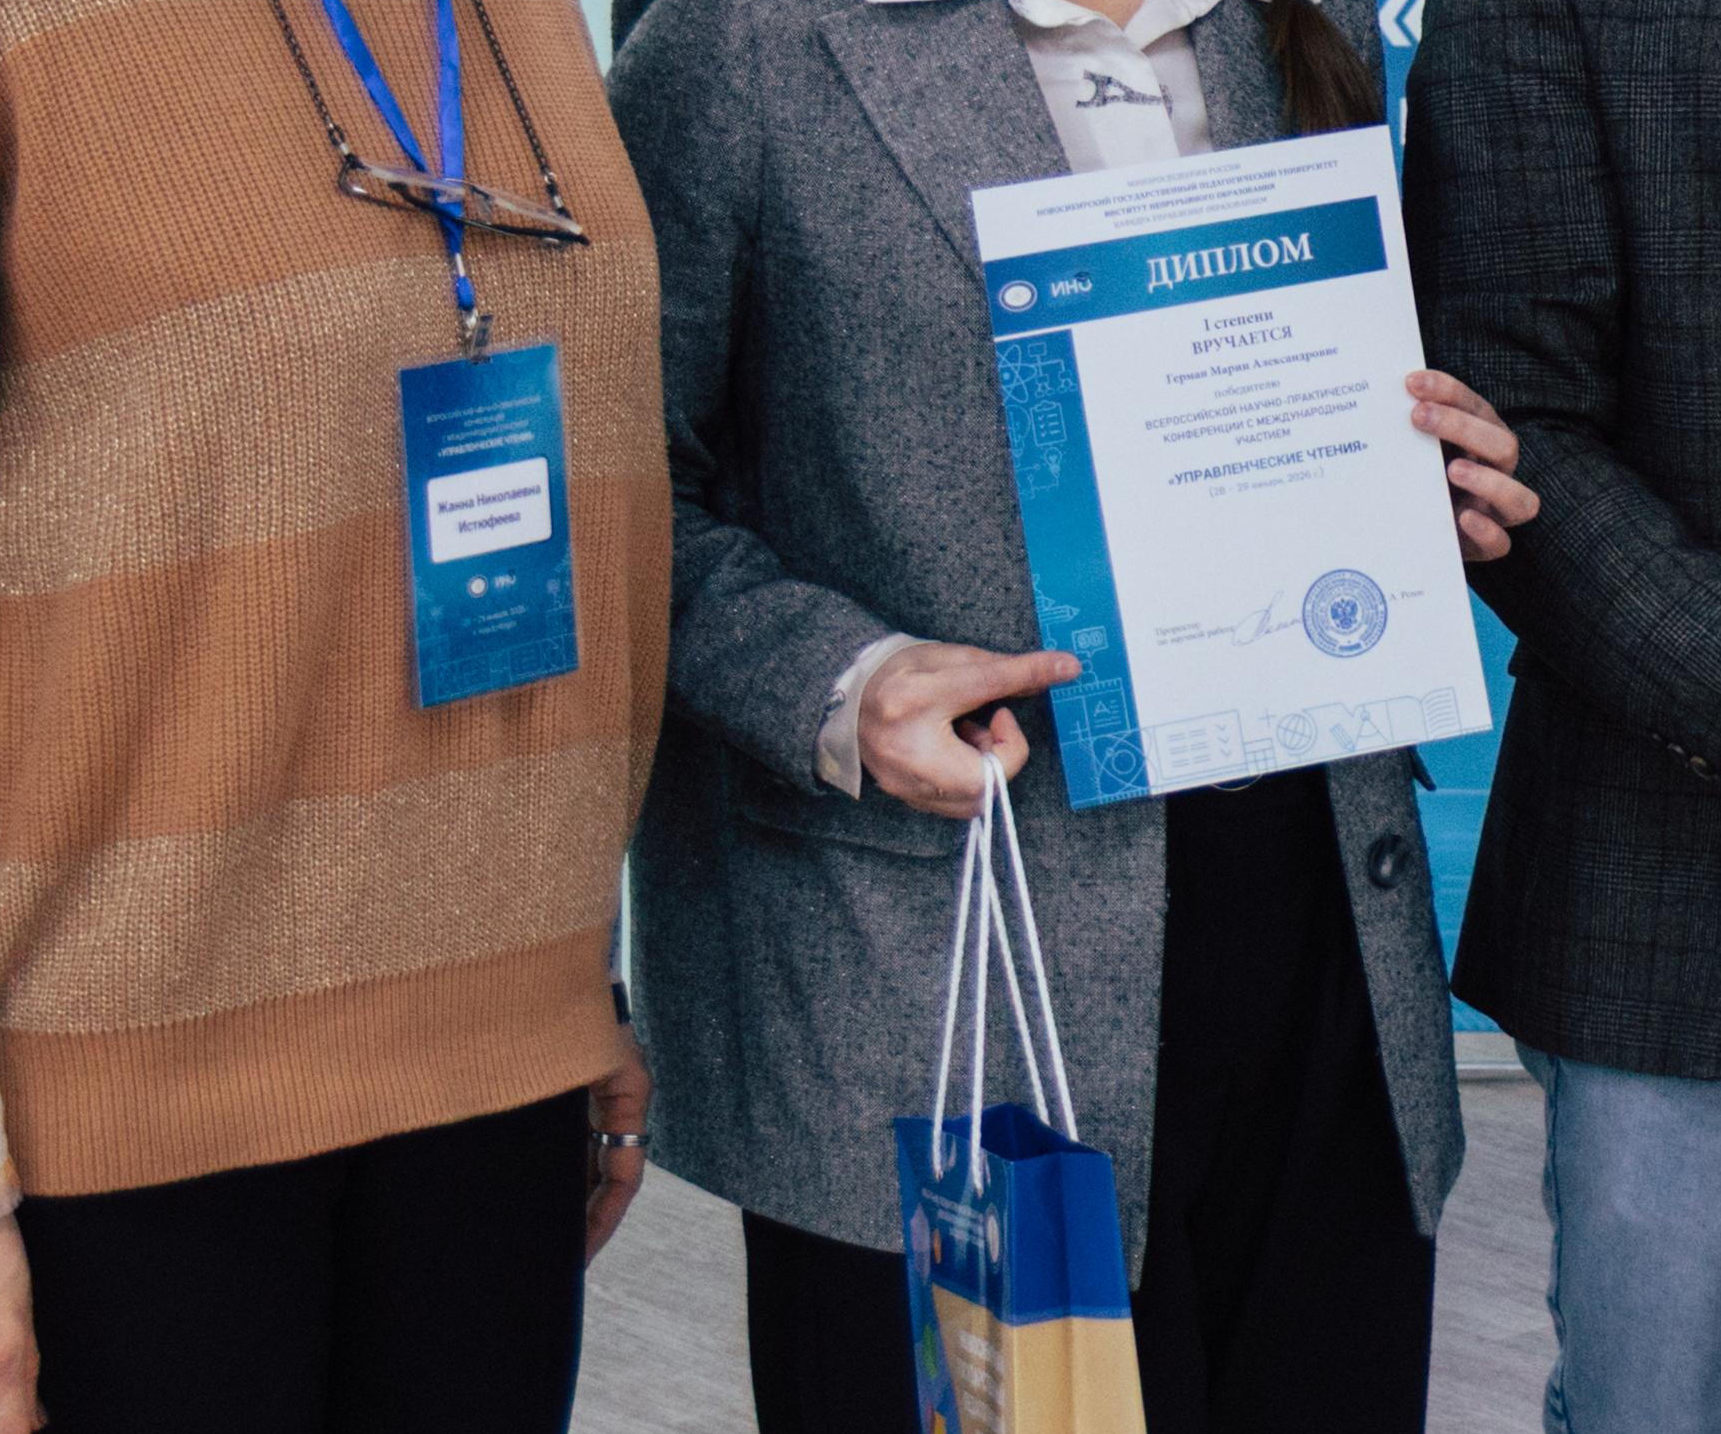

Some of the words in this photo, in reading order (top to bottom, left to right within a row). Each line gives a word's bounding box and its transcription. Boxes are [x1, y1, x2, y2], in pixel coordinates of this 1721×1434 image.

[1148, 233, 1313, 292] ДИПЛОМ
[1192, 326, 1292, 354] ВРУЧАЕТСЯ
[1203, 318, 1211, 332] I
[1214, 312, 1273, 329] степени
[1145, 404, 1237, 430] ВСЕРОССИЙСКОЙ
[1239, 381, 1369, 412] НАУЧНО-ПРАКТИЧЕСКОЙ
[1163, 421, 1244, 442] КОНФЕРЕНЦИИ
[1246, 418, 1254, 429] С
[1256, 401, 1357, 426] МЕЖДУНАРОДНЫМ
[1236, 428, 1290, 445] УЧАСТИЕМ
[1169, 451, 1303, 484] «УПРАВЛЕНЧЕСКИЕ
[1307, 440, 1367, 459] ЧТЕНИЯ»
